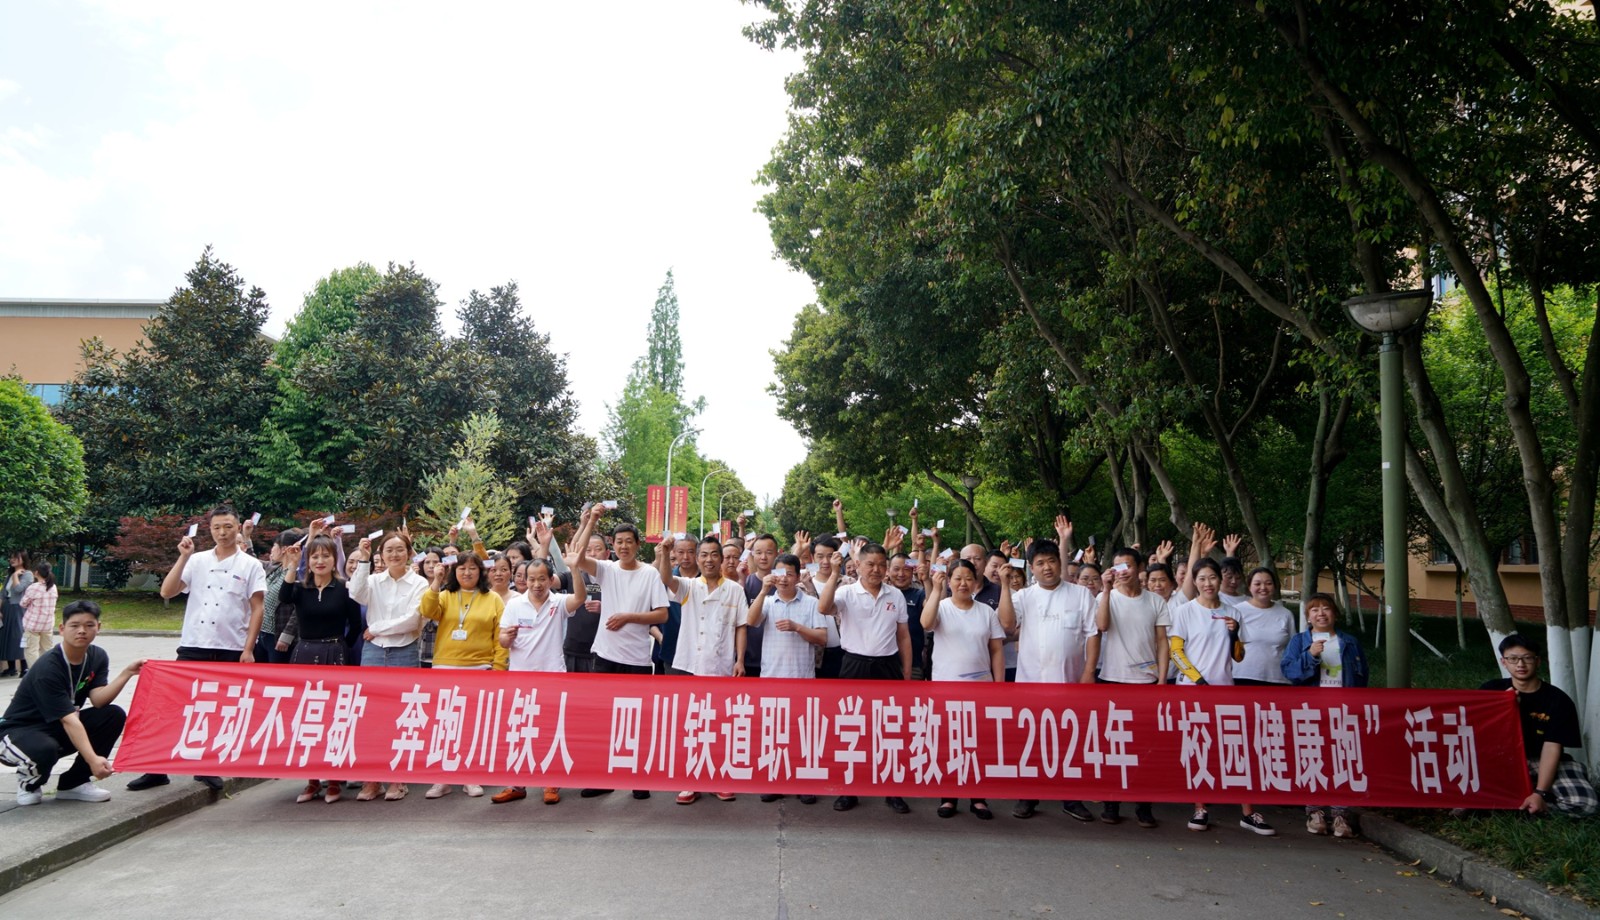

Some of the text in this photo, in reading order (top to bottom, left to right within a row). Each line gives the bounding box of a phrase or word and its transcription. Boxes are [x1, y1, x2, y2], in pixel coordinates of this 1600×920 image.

[170, 678, 367, 768] 运动不停歇
[390, 683, 575, 776] 奔跑川铁人
